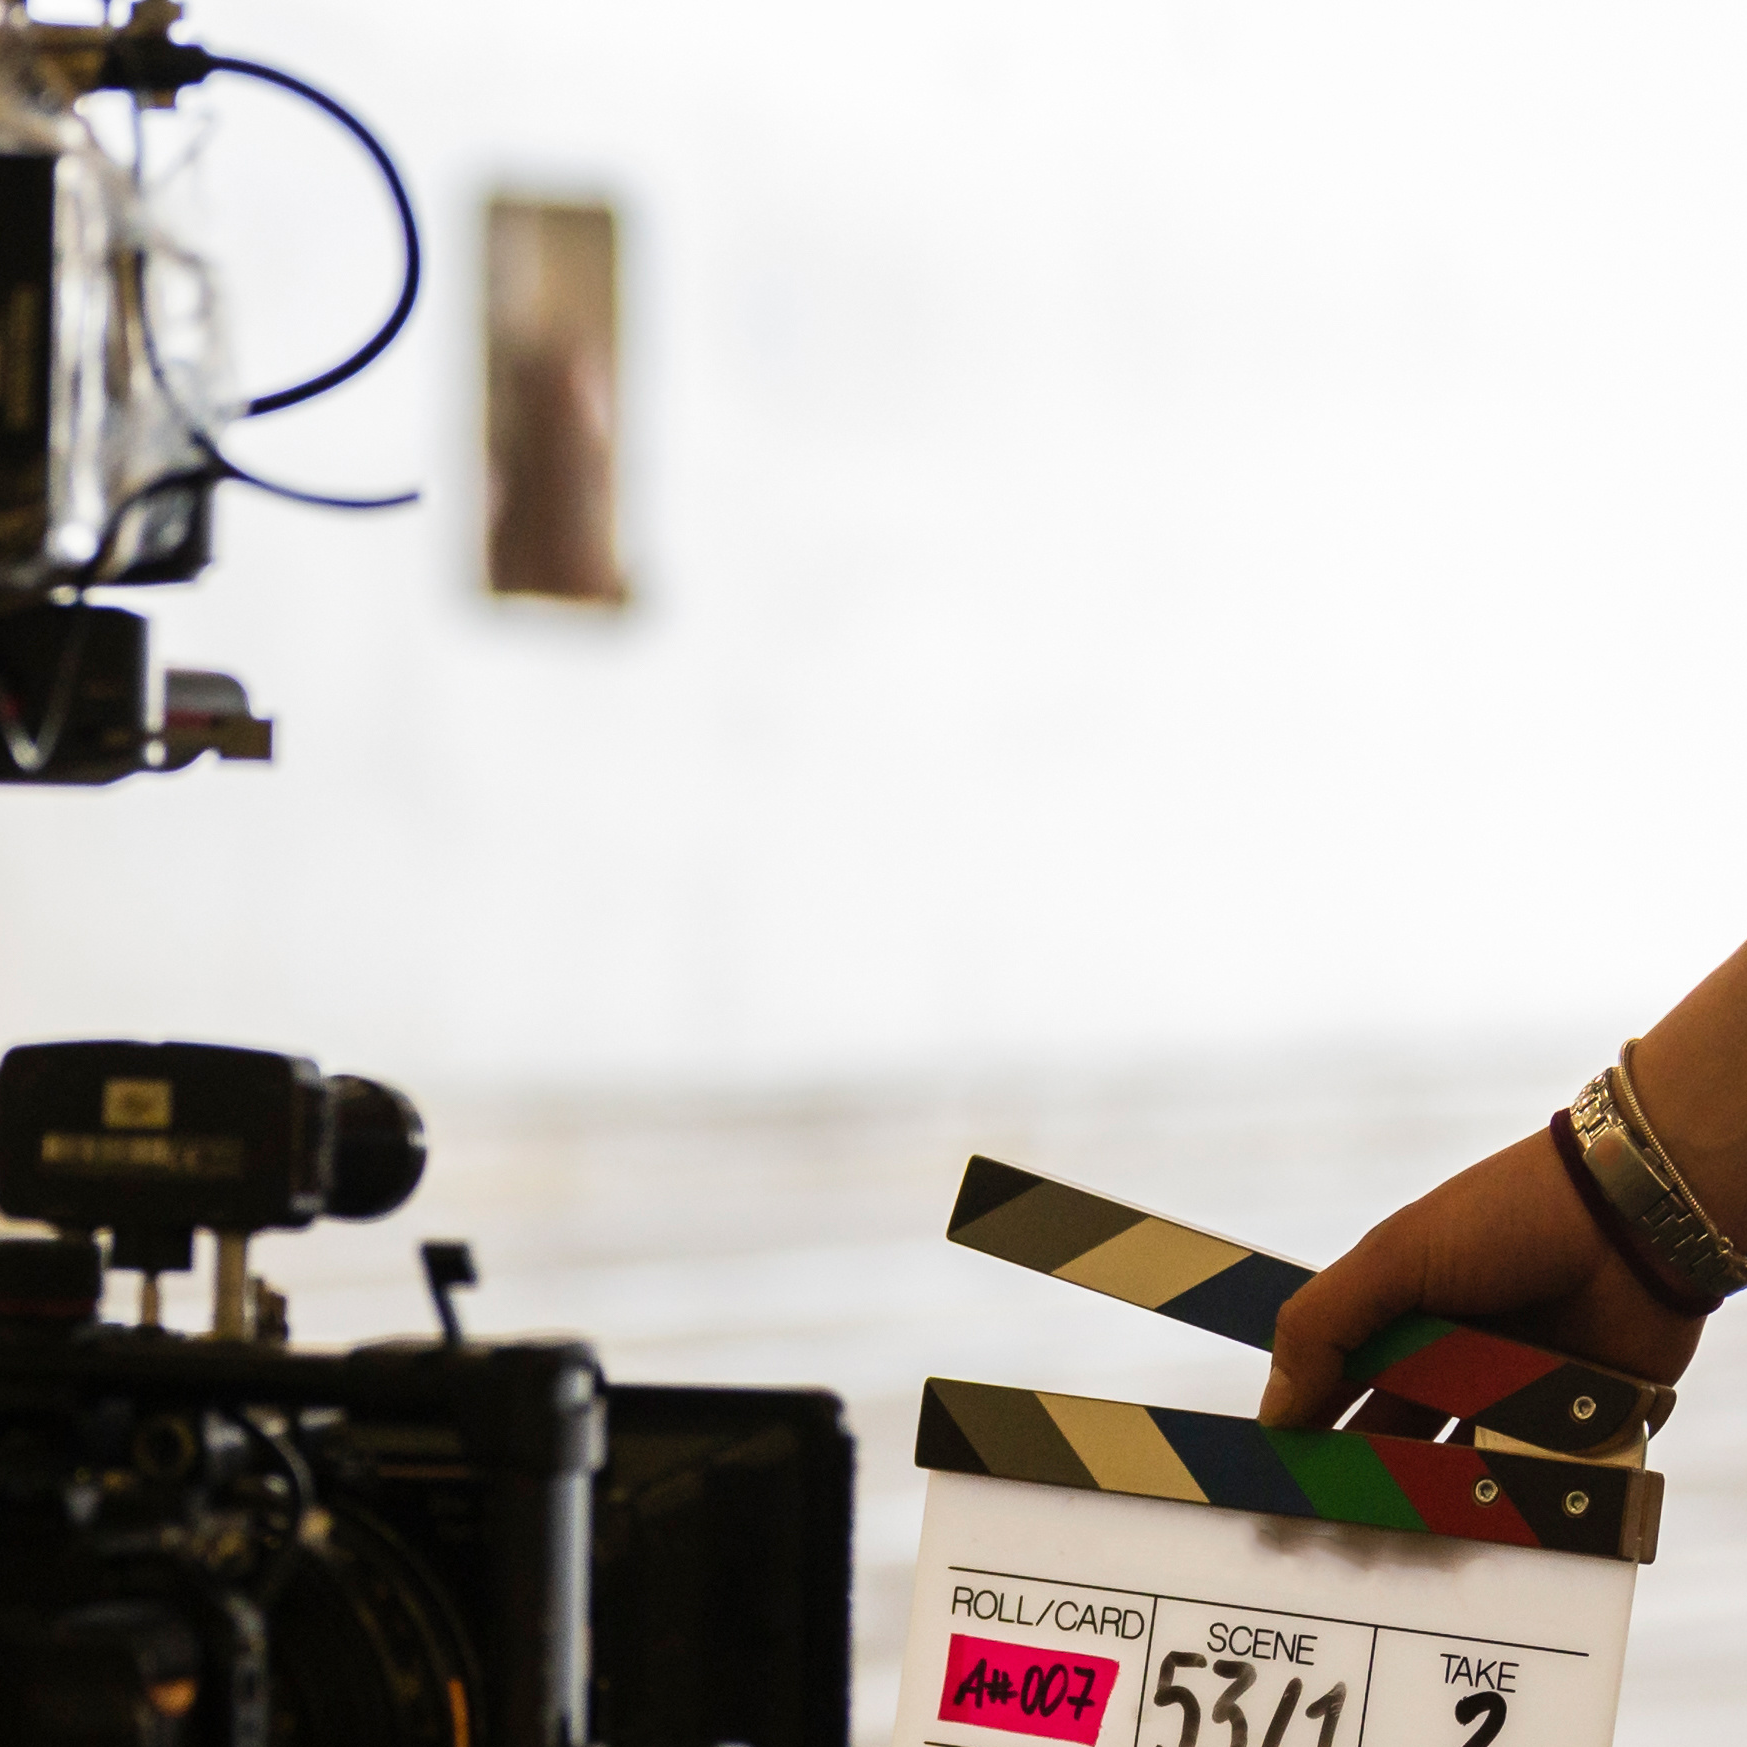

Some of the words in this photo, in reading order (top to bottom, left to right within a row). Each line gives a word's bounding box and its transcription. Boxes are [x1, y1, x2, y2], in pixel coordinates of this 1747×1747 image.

[951, 1586, 1145, 1640] ROLL/CARD
[1207, 1622, 1318, 1665] SCENE
[1440, 1653, 1519, 1693] TAKE
